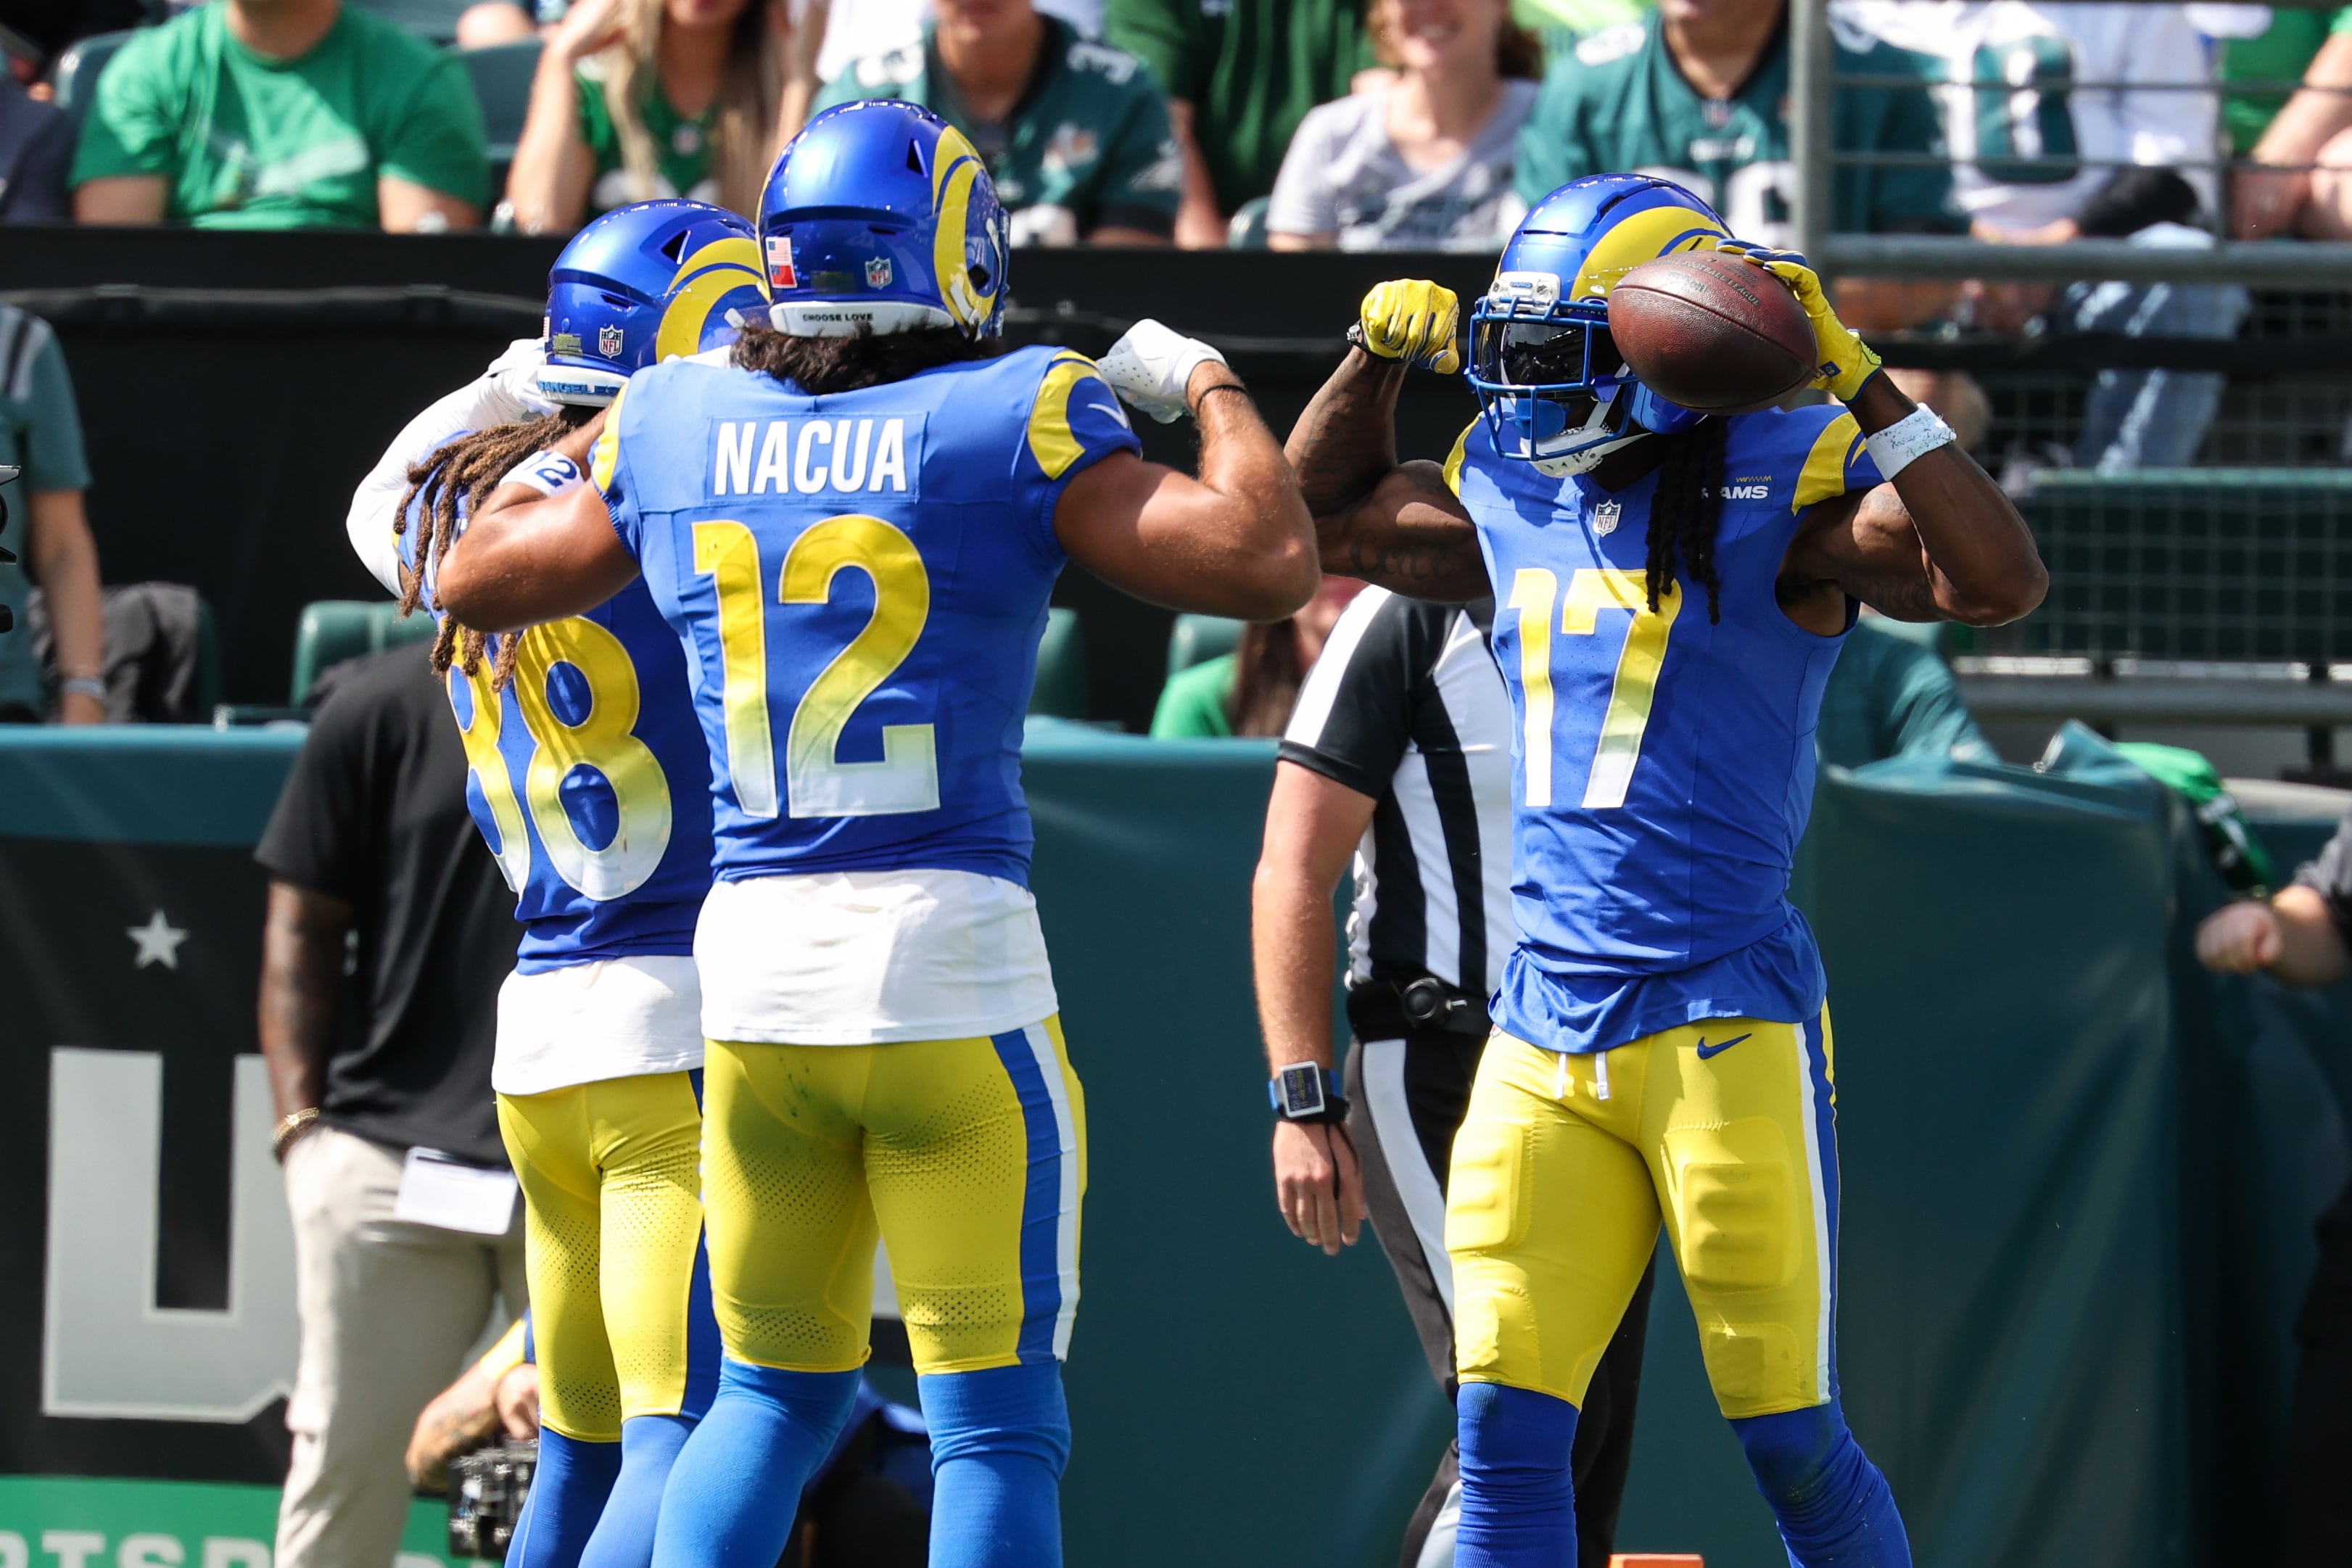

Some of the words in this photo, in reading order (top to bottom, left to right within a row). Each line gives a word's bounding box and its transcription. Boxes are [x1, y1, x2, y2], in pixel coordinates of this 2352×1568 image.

[870, 270, 890, 285] NFL
[1682, 260, 1727, 283] FOOTBALL
[803, 313, 841, 322] CHOOSE
[845, 313, 874, 322] LOVE
[603, 339, 619, 353] NFL
[714, 418, 907, 496] NACUA
[1598, 516, 1614, 529] NFL
[691, 513, 941, 818] 12
[1507, 568, 1683, 809] 17
